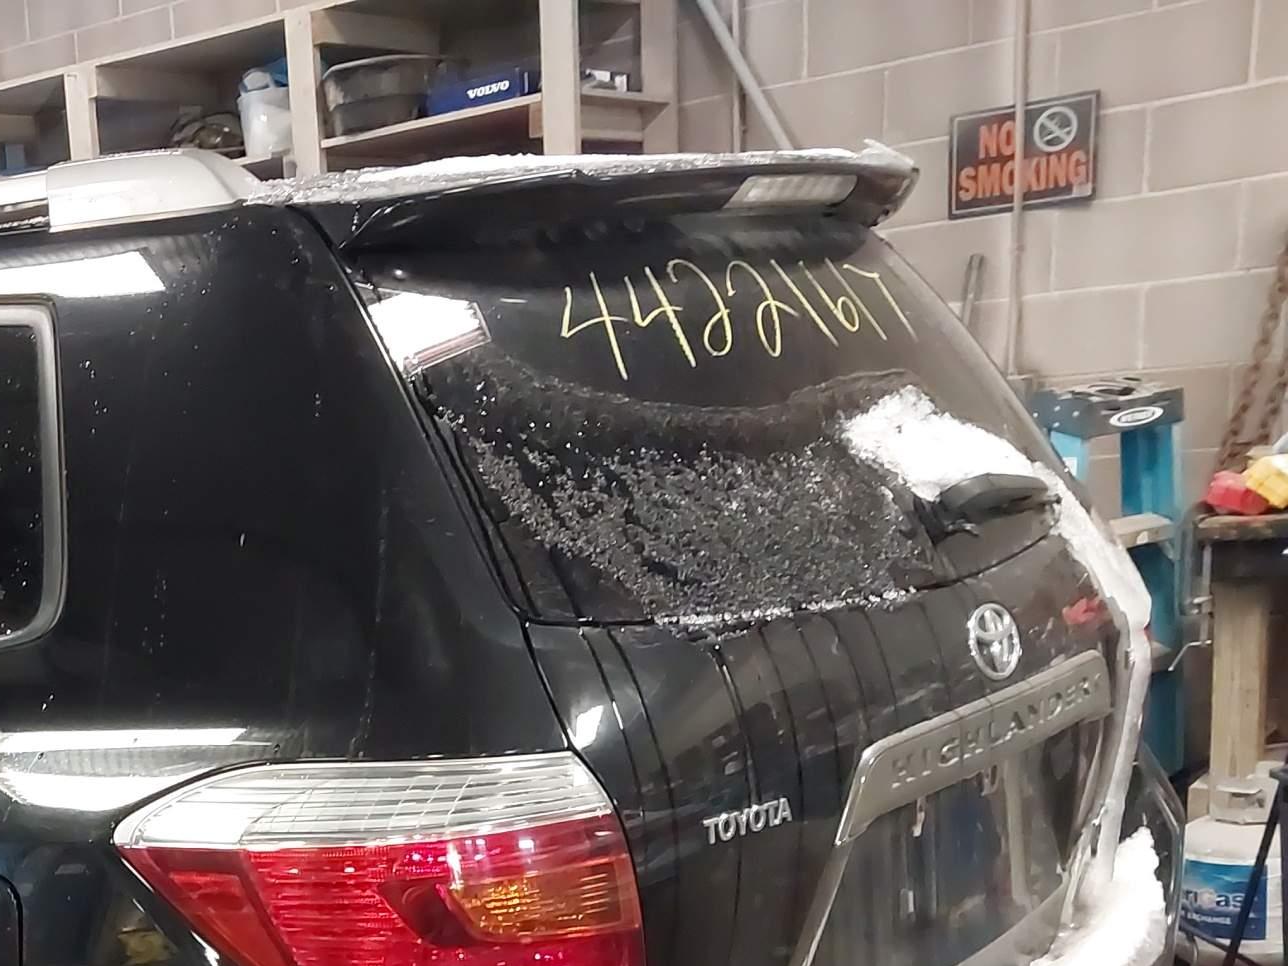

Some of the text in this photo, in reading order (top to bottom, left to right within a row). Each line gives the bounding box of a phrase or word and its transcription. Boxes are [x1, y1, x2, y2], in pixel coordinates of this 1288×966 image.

[467, 80, 510, 100] VOLVO
[978, 120, 1017, 159] NO
[958, 150, 1088, 202] SMOKING
[560, 257, 918, 381] 44221617
[703, 798, 792, 844] TOYOTA
